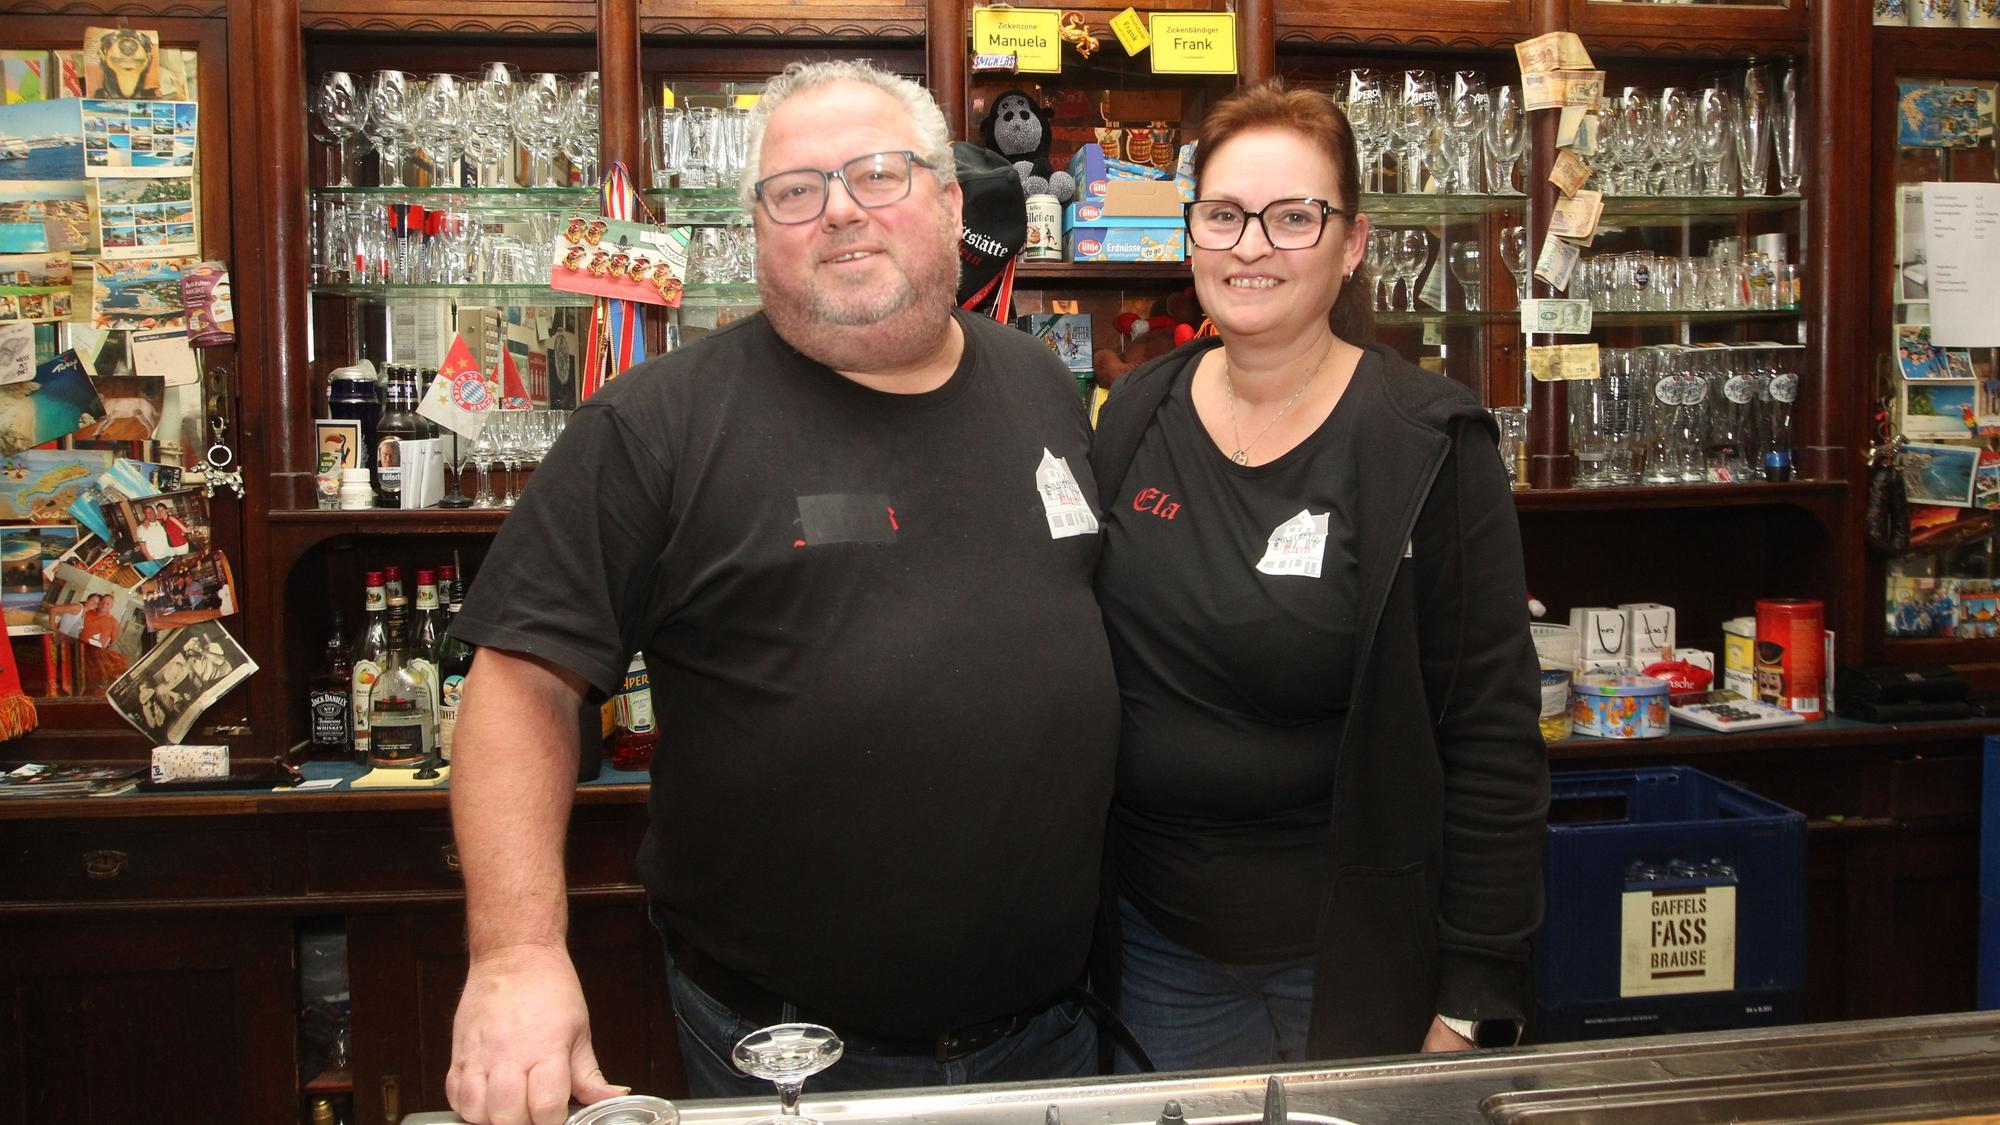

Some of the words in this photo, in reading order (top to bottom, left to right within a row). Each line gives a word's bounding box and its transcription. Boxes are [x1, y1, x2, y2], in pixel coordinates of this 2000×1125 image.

[997, 22, 1038, 30] Zickenzone
[1122, 20, 1138, 42] Frank
[1166, 26, 1219, 35] Zickenbändiger
[989, 33, 1047, 48] Manuela
[1173, 37, 1213, 50] Frank
[975, 54, 1016, 67] SNICKERS
[1093, 182, 1106, 193] ültj
[1082, 208, 1099, 217] ültje
[1081, 242, 1100, 254] ültje
[1106, 242, 1142, 253] Erdnüsse
[1146, 248, 1153, 257] to
[1153, 247, 1162, 257] go
[185, 287, 206, 295] MASKE
[1132, 487, 1181, 520] Ela
[311, 696, 326, 707] JACK
[1651, 898, 1707, 917] GAFFELS
[1651, 918, 1707, 948] FASS
[1650, 950, 1707, 969] BRAUSE
